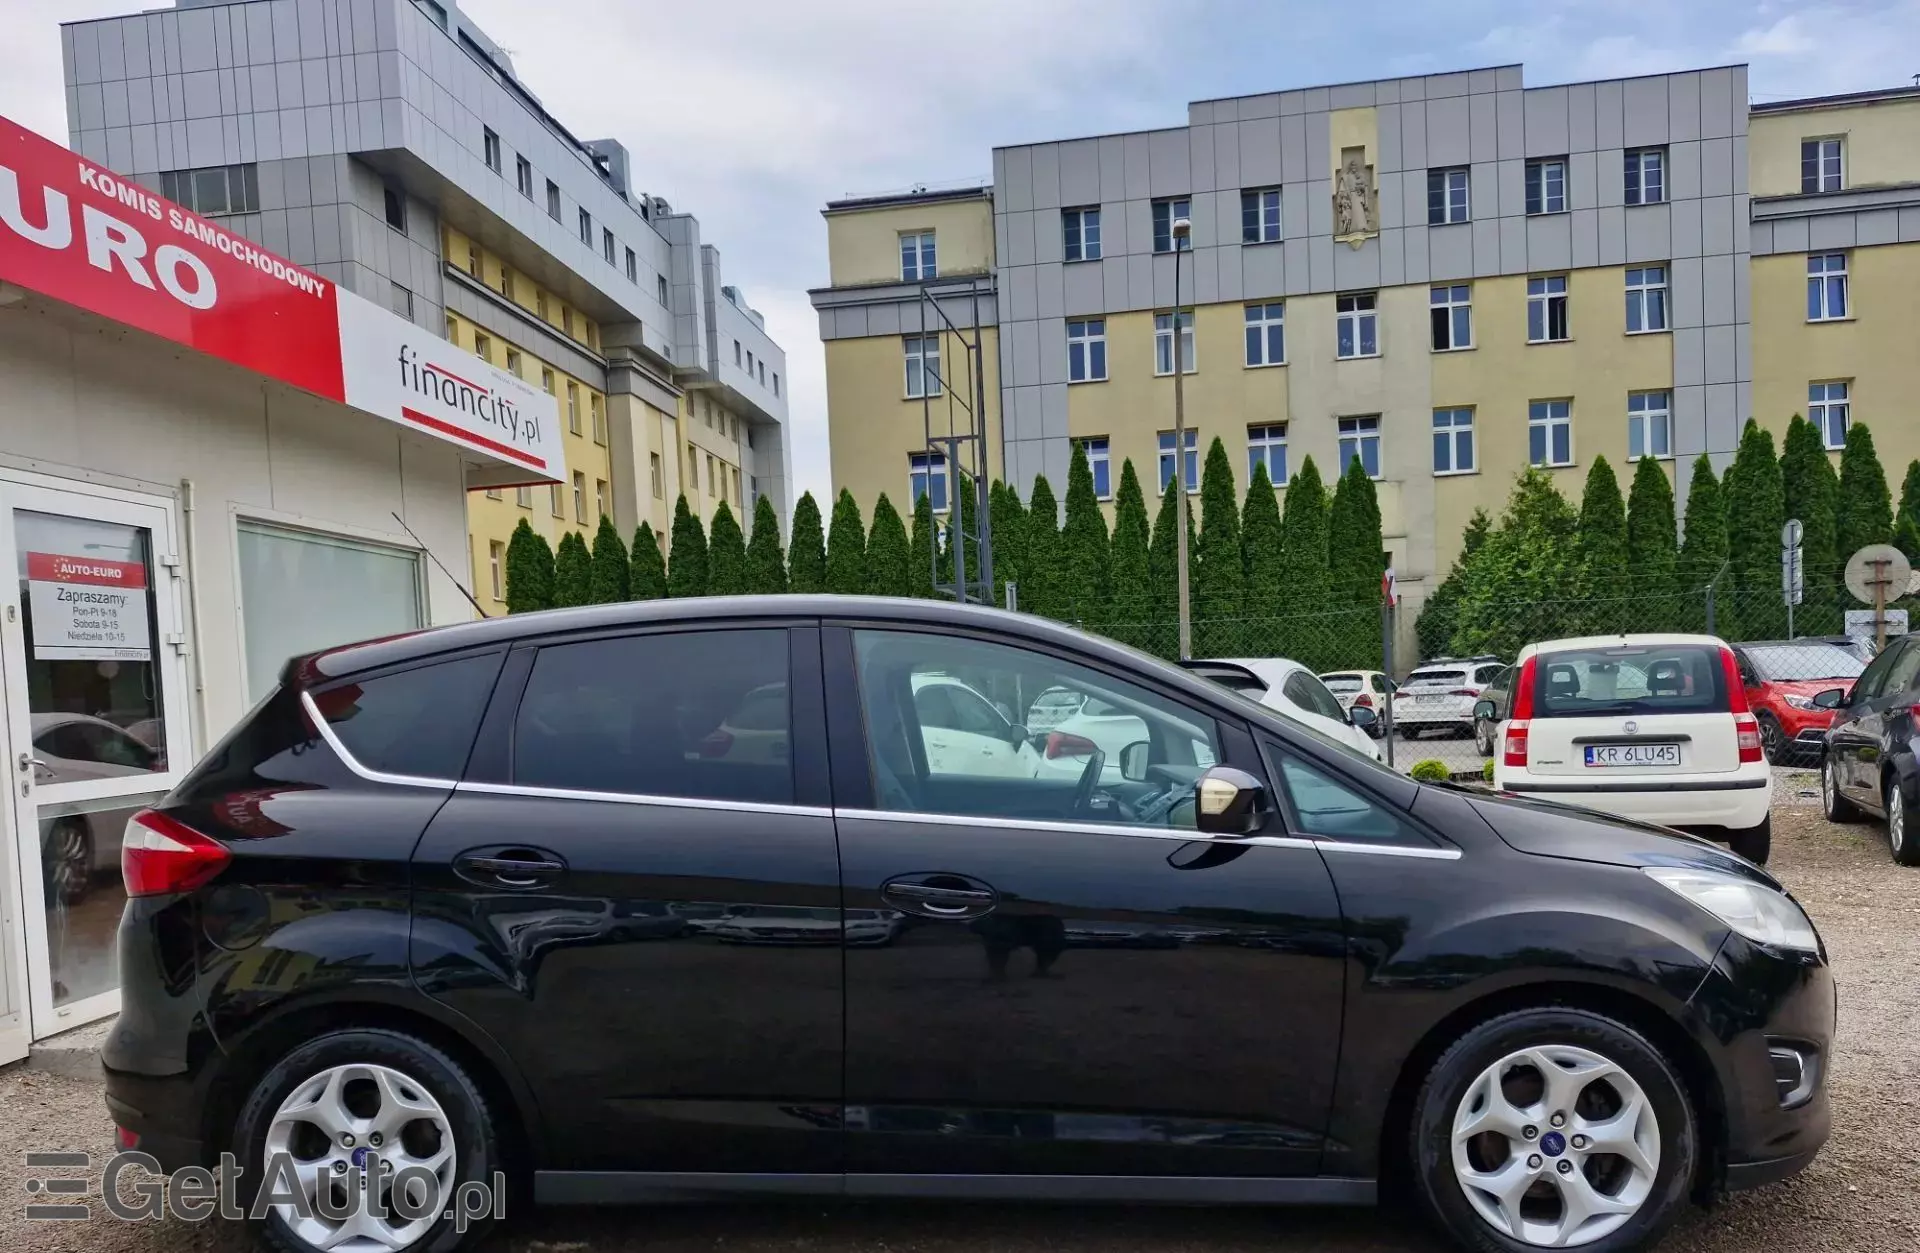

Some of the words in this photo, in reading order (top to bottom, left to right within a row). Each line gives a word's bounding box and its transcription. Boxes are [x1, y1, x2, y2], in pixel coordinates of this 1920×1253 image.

[78, 162, 162, 221] KOMIS
[168, 207, 326, 299] SAMOCHODOWY
[398, 344, 541, 446] financity.pl
[61, 562, 122, 578] AUTO-EURO
[72, 606, 99, 617] Pon-Pt
[100, 607, 118, 618] 9-18
[73, 618, 101, 629] Sobota
[101, 620, 119, 630] 9-15
[67, 631, 103, 641] Niedziela
[105, 632, 126, 642] 10-15
[1596, 747, 1618, 762] KR
[1624, 746, 1675, 761] 6LU45
